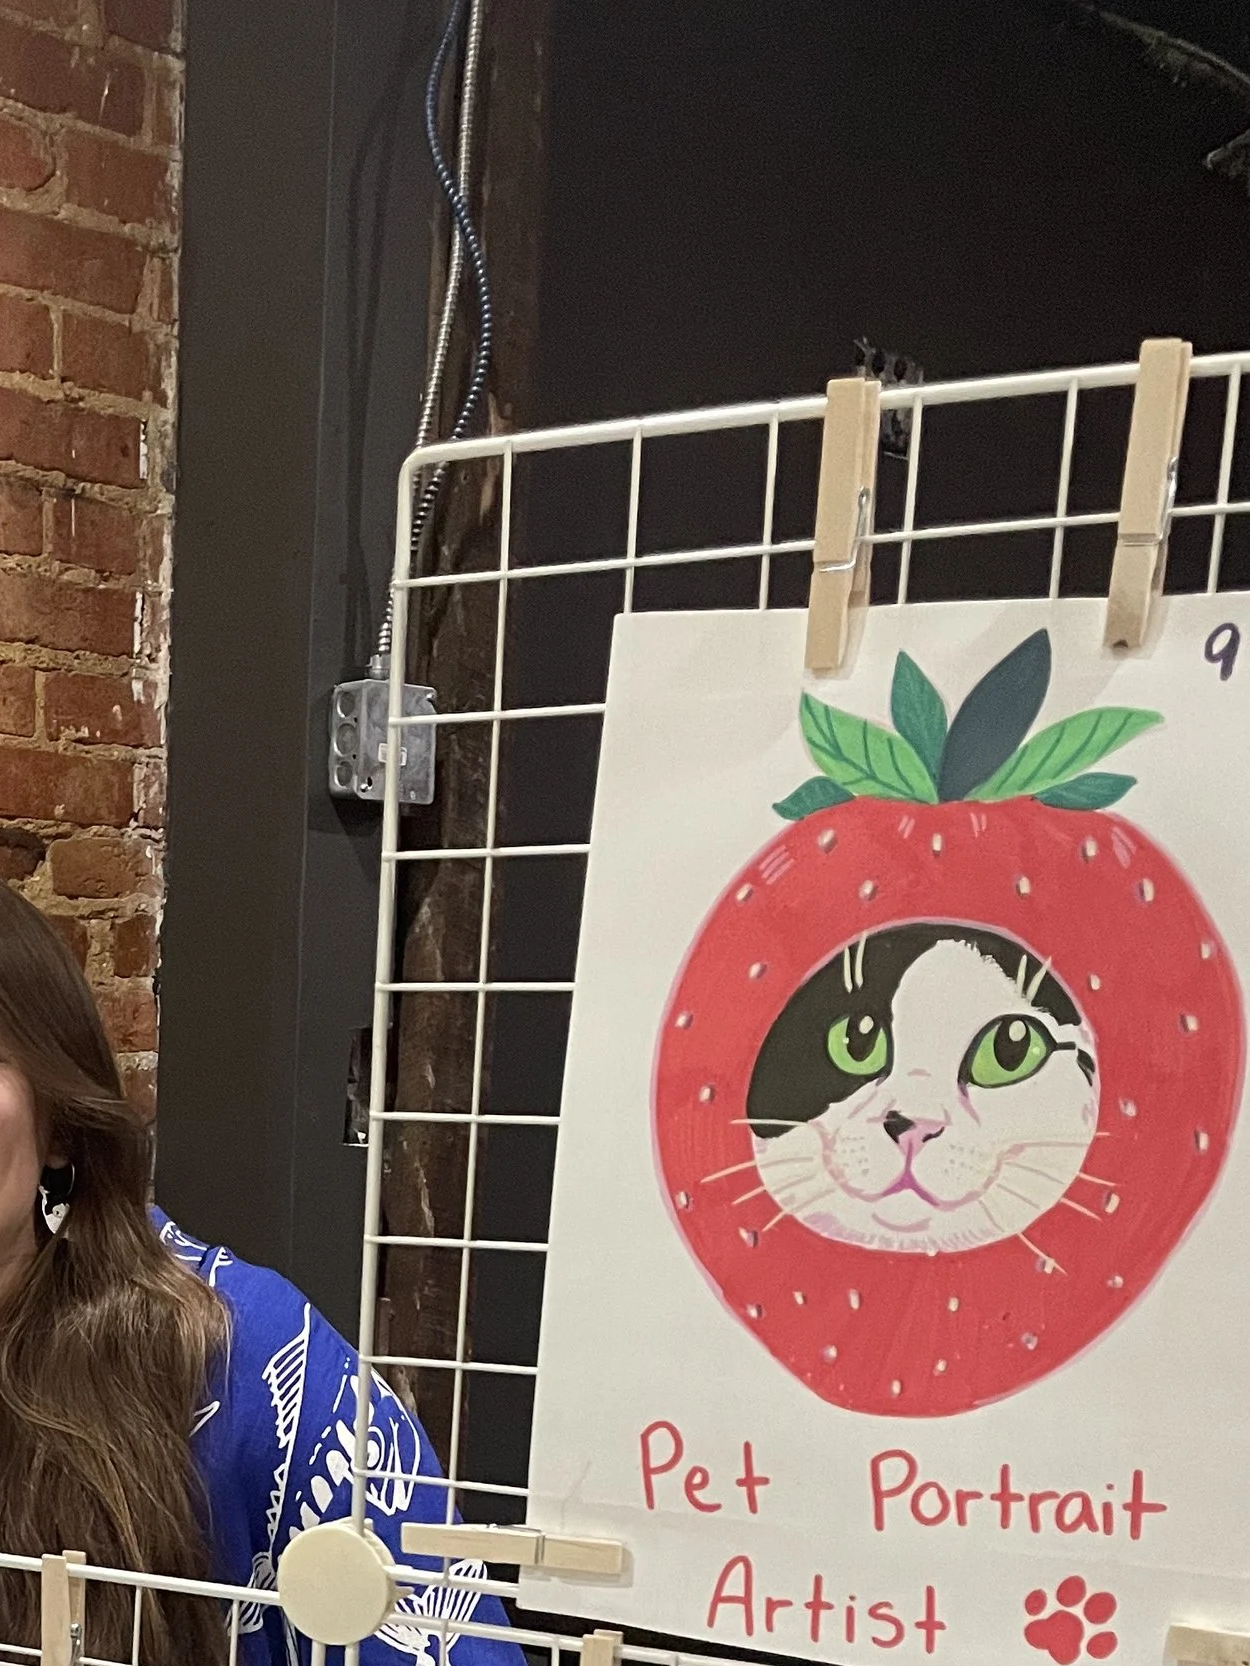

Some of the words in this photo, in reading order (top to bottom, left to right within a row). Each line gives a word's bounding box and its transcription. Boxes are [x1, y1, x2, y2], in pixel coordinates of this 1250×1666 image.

[641, 1421, 770, 1513] Pet
[869, 1449, 1168, 1540] Portrait
[707, 1555, 947, 1654] Artist
